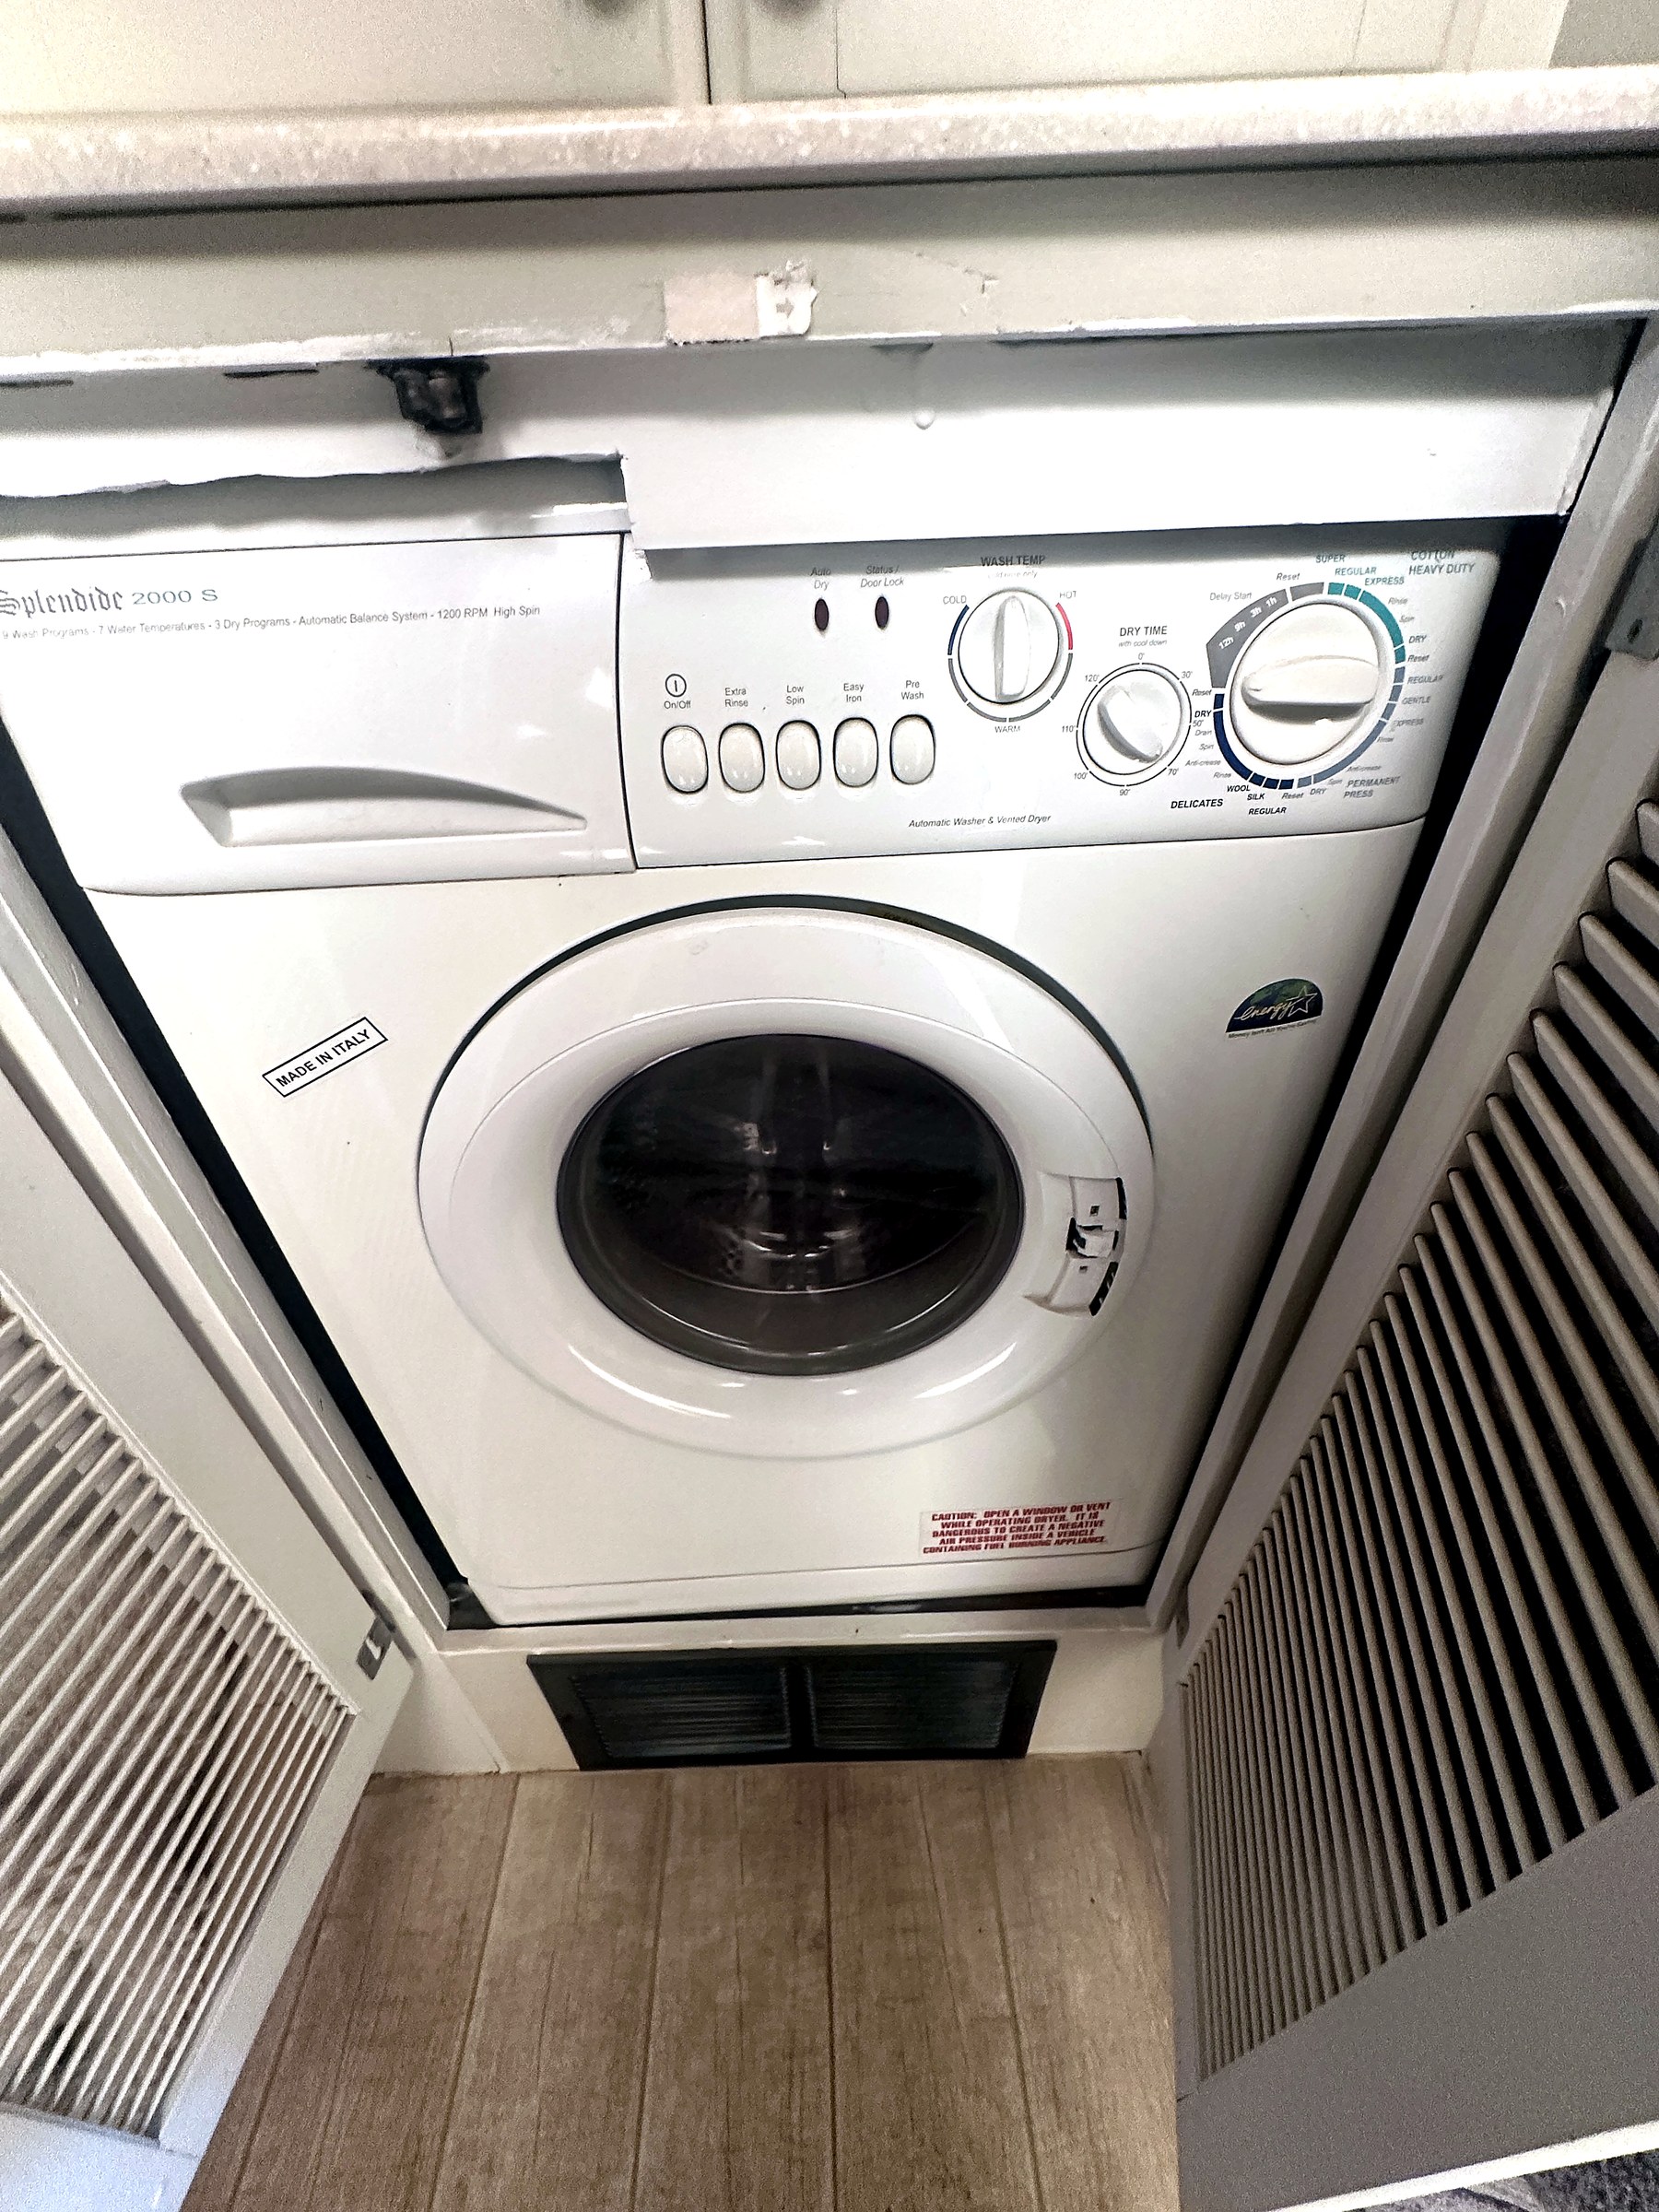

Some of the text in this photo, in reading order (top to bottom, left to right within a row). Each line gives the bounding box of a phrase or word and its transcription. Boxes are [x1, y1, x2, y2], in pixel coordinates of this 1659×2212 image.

[981, 555, 1046, 567] WASH TEMP
[1316, 554, 1347, 563] SUPER
[810, 566, 831, 577] Auto
[1335, 567, 1377, 576] REGULAR
[1409, 562, 1476, 575] HEAVY DUTY
[860, 576, 904, 588] Door Lock
[1277, 572, 1300, 581] Reset
[1364, 576, 1405, 586] EXPRESS
[814, 579, 830, 591] Dry
[132, 590, 192, 605] 2000
[202, 589, 218, 602] S
[943, 594, 967, 605] COLD
[1059, 590, 1077, 599] HOT
[1210, 591, 1253, 602] Delay Start
[1265, 596, 1277, 607] 1h
[1250, 606, 1262, 618] 3h
[13, 629, 38, 639] Wash
[42, 628, 89, 640] Programs
[99, 625, 103, 634] 7
[108, 624, 136, 634] Water
[140, 622, 206, 633] Temperatures
[215, 619, 220, 629] 3
[224, 618, 241, 631] Dry
[243, 617, 290, 629] Programs
[299, 613, 347, 626] Automatic
[350, 612, 389, 624] Balance
[392, 610, 428, 624] System
[437, 609, 461, 619] 1200
[464, 607, 488, 618] RPM
[494, 606, 515, 618] High
[519, 605, 541, 618] Spin
[1119, 625, 1168, 637] DRY TIME
[1218, 636, 1234, 649] 12h
[1409, 634, 1427, 644] DRY
[1407, 654, 1430, 663] Reset
[905, 679, 920, 689] Pre
[1407, 674, 1444, 685] REGULAR
[724, 687, 747, 697] Extra
[786, 684, 804, 694] Low
[843, 681, 865, 694] Easy
[786, 695, 805, 706] Spin
[845, 693, 862, 703] Iron
[900, 690, 924, 700] Wash
[664, 700, 691, 710] On/Off
[724, 698, 748, 708] Rinse
[1194, 710, 1212, 718] DRY
[994, 724, 1020, 734] WARM
[1347, 775, 1401, 788] PERMANENT
[1227, 784, 1251, 793] WOOL
[1310, 787, 1327, 795] DRY
[1344, 789, 1374, 799] PRESS
[1247, 793, 1265, 801] SILK
[1171, 798, 1224, 809] DELICATES
[1248, 806, 1287, 816] REGULAR
[908, 813, 1052, 829] Automatic Washer & Vented Dryer
[276, 1029, 371, 1087] MADE IN ITALY
[932, 1512, 977, 1522] CAUTION:
[983, 1509, 1010, 1519] OPEN
[1012, 1509, 1019, 1517] A
[1022, 1505, 1068, 1516] WINDOW
[1086, 1501, 1111, 1512] VENT
[941, 1520, 971, 1529] WHILE
[975, 1516, 1031, 1527] OPERATING
[1076, 1512, 1086, 1521] IT
[932, 1527, 990, 1538] DANGEROUS
[1009, 1524, 1045, 1533] CREATE
[1058, 1519, 1105, 1530] NEGATIVE
[939, 1528, 1096, 1546] AIR PRESSURE INSIDE A VEHICLE
